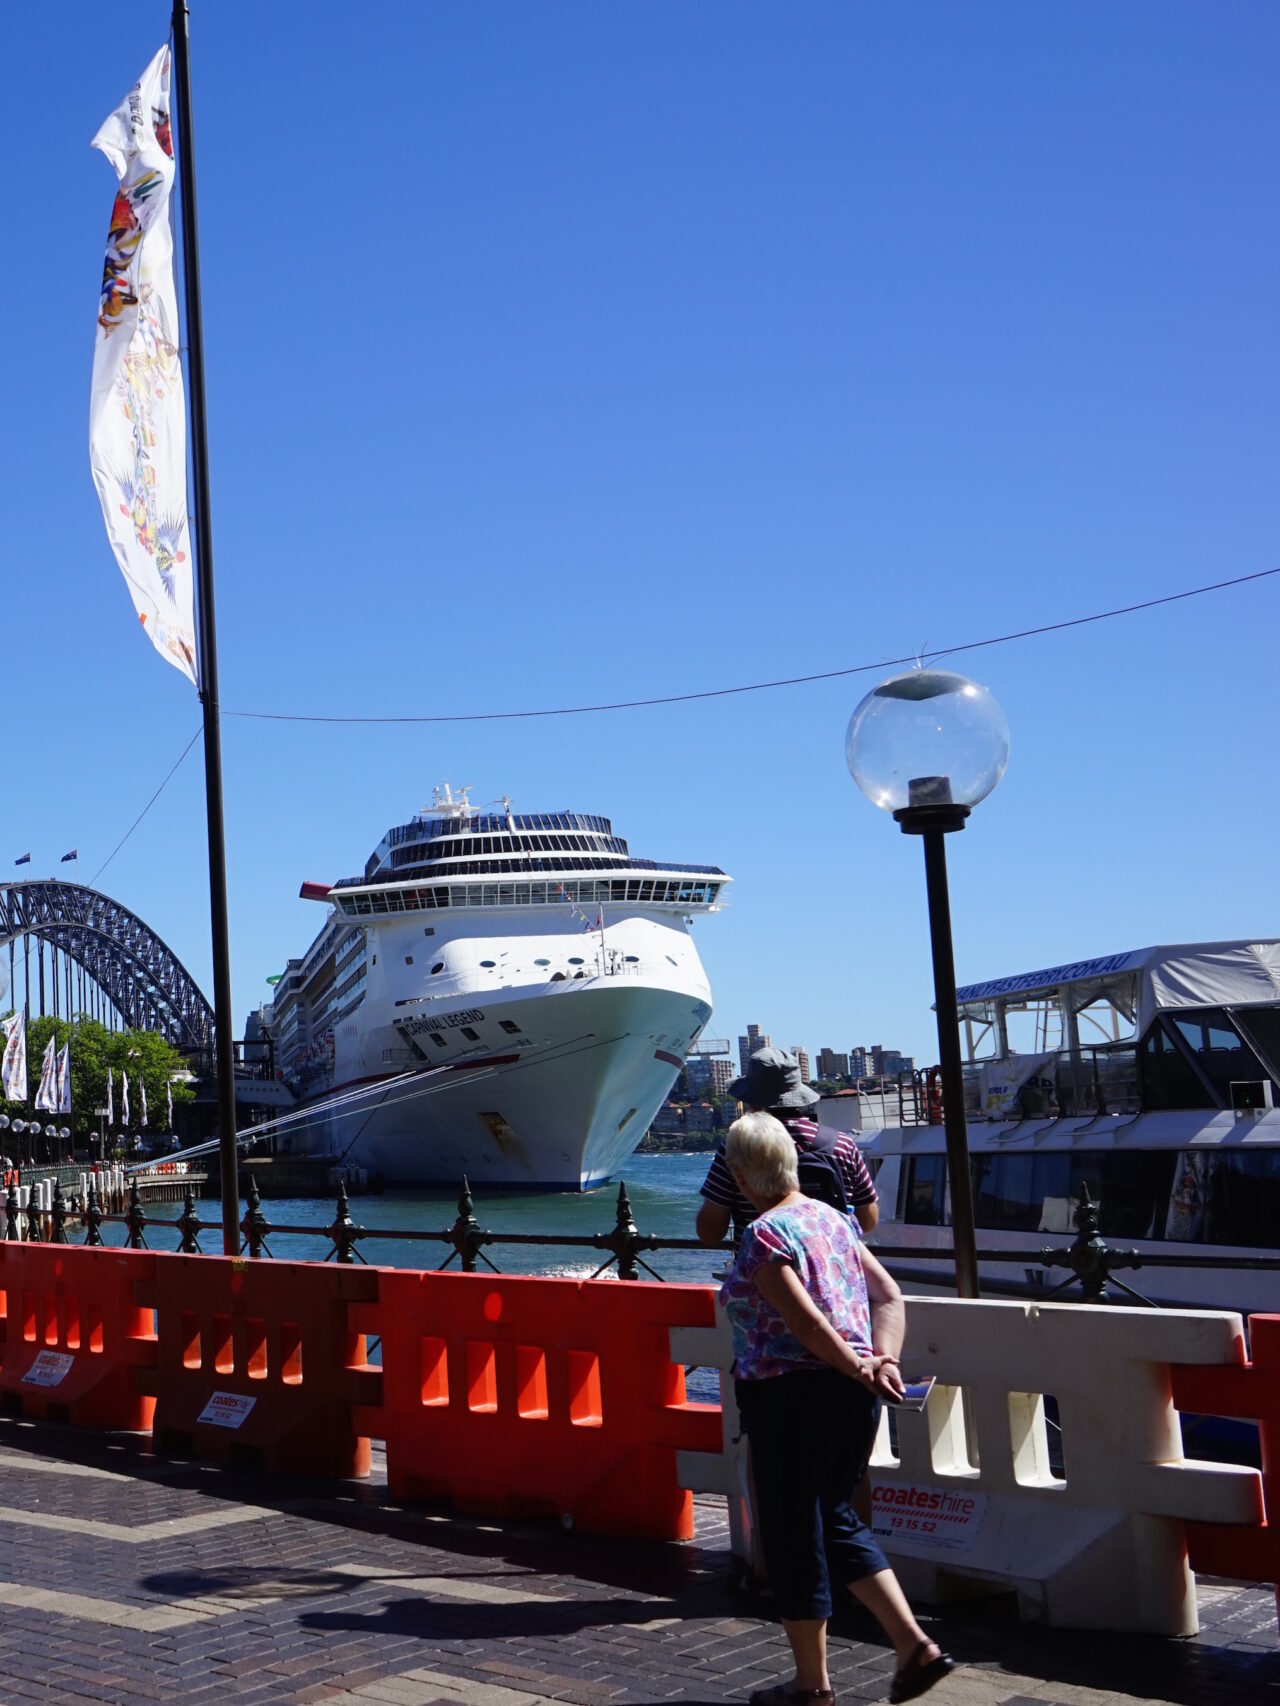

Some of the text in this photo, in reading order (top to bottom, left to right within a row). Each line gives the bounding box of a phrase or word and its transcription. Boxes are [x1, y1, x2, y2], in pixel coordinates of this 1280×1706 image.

[405, 1009, 485, 1036] CARNIVAL LEGEND
[890, 1517, 937, 1533] 13 15 52
